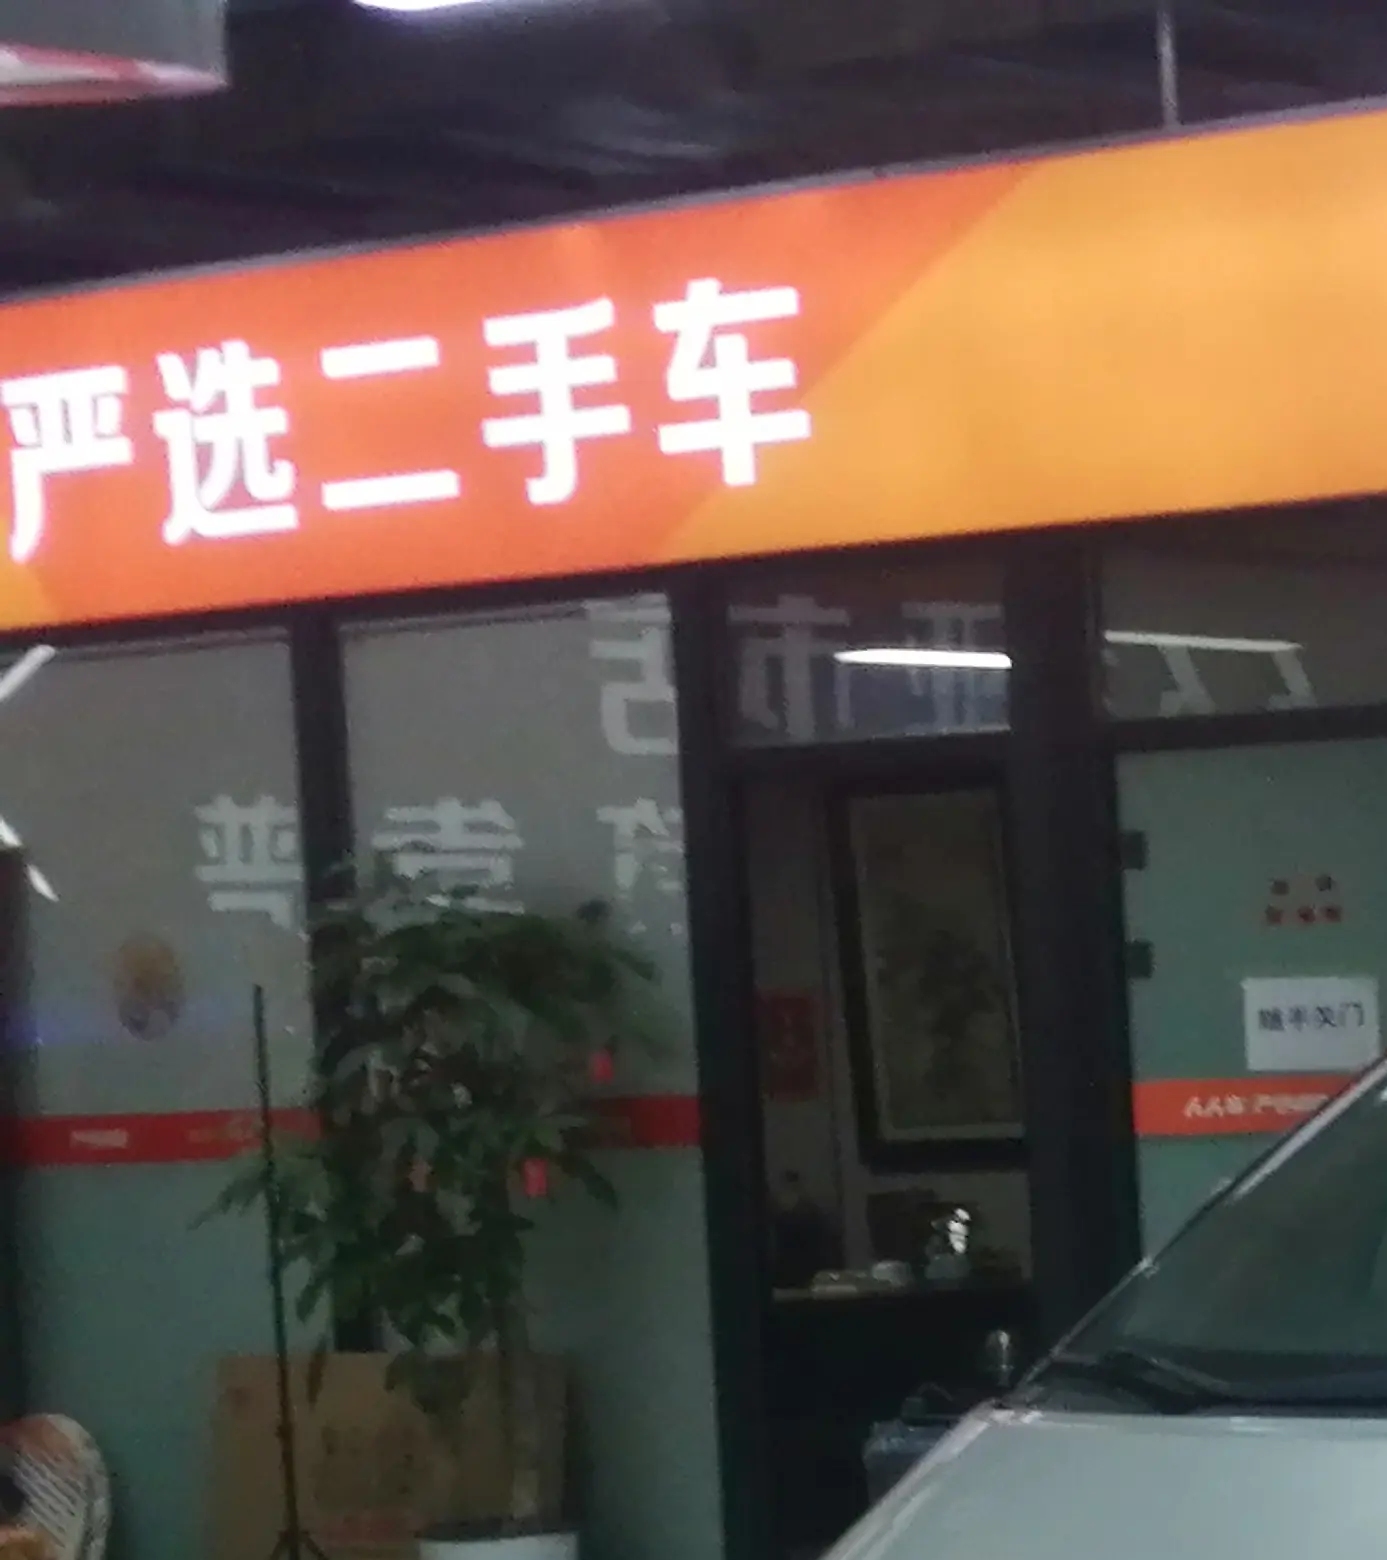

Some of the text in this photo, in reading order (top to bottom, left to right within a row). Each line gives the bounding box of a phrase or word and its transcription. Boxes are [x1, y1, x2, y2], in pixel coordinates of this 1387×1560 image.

[0, 278, 812, 562] 严选二手车
